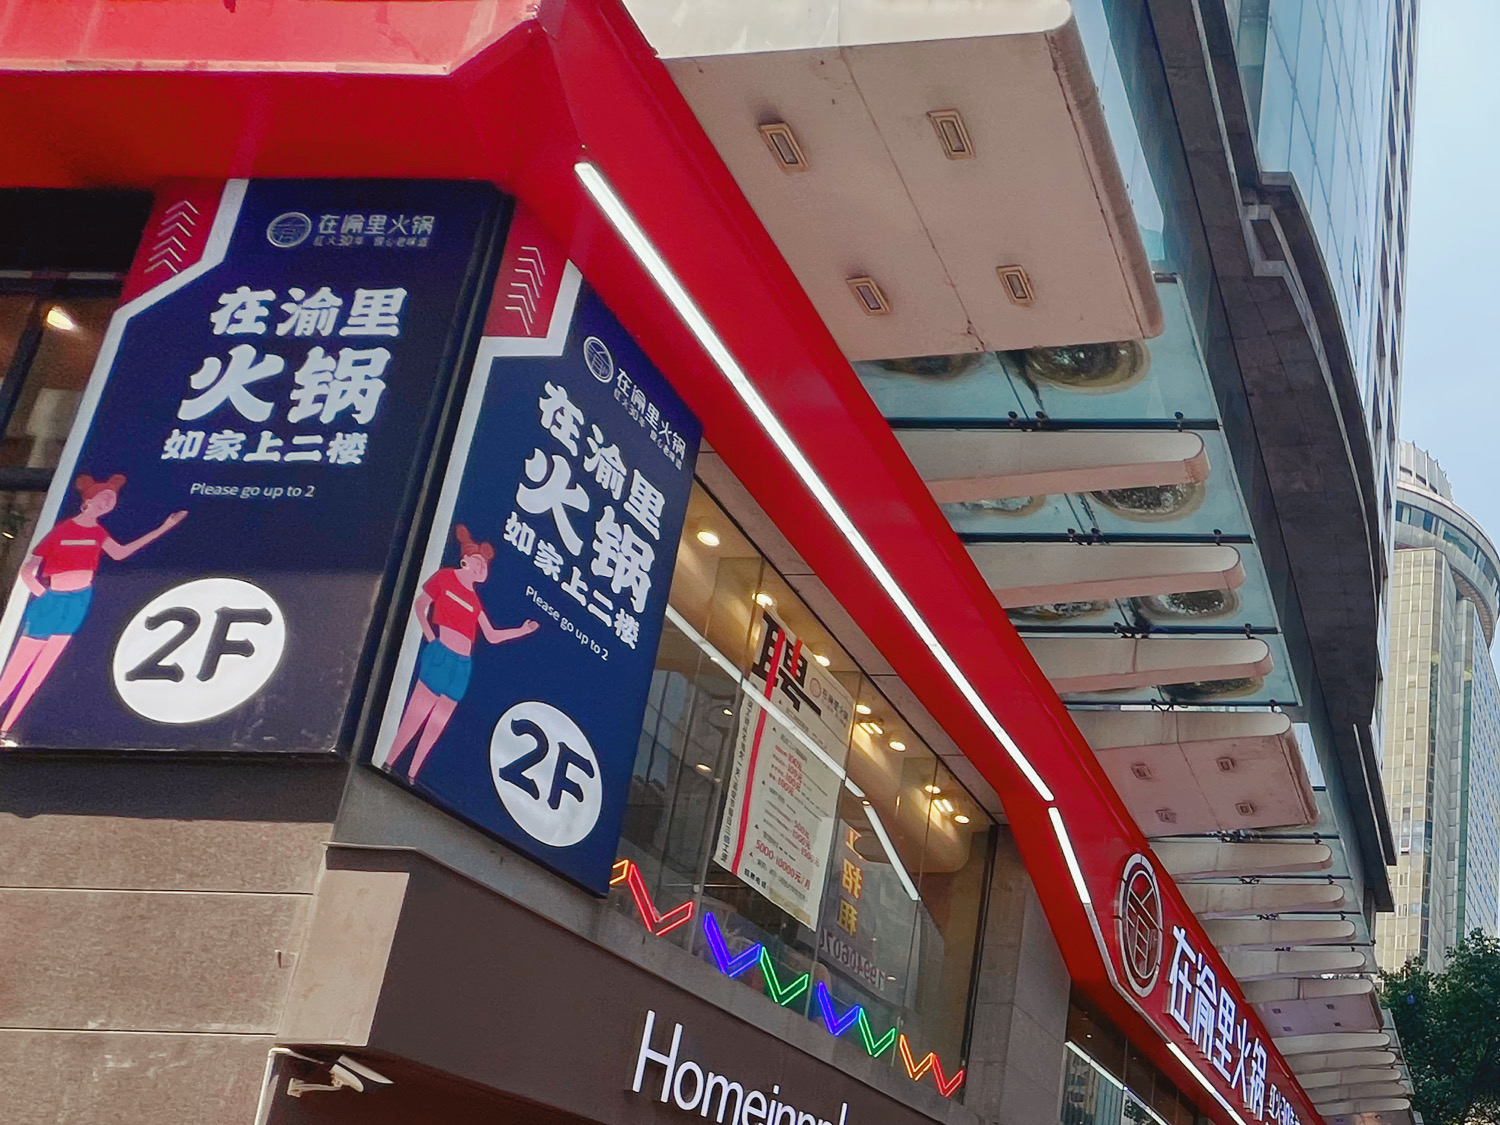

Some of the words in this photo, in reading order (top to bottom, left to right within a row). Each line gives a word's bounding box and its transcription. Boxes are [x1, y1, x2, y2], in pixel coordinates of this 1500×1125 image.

[209, 285, 408, 338] 在渝里
[177, 343, 392, 425] 火锅
[161, 428, 369, 465] 如家上二楼
[538, 381, 666, 540] 在渝里
[190, 482, 239, 497] Please
[240, 487, 260, 499] go
[263, 486, 283, 499] up
[286, 485, 303, 497] to
[304, 485, 315, 497] 2
[516, 447, 655, 613] 火锅
[502, 511, 643, 650] 如家上二楼
[125, 606, 273, 682] 2F
[525, 585, 561, 627] Please
[560, 614, 575, 634] go
[575, 626, 588, 645] up
[589, 635, 600, 653] to
[600, 647, 610, 660] 2
[498, 718, 596, 810] 2F
[1169, 925, 1268, 1122] 在渝里火锅
